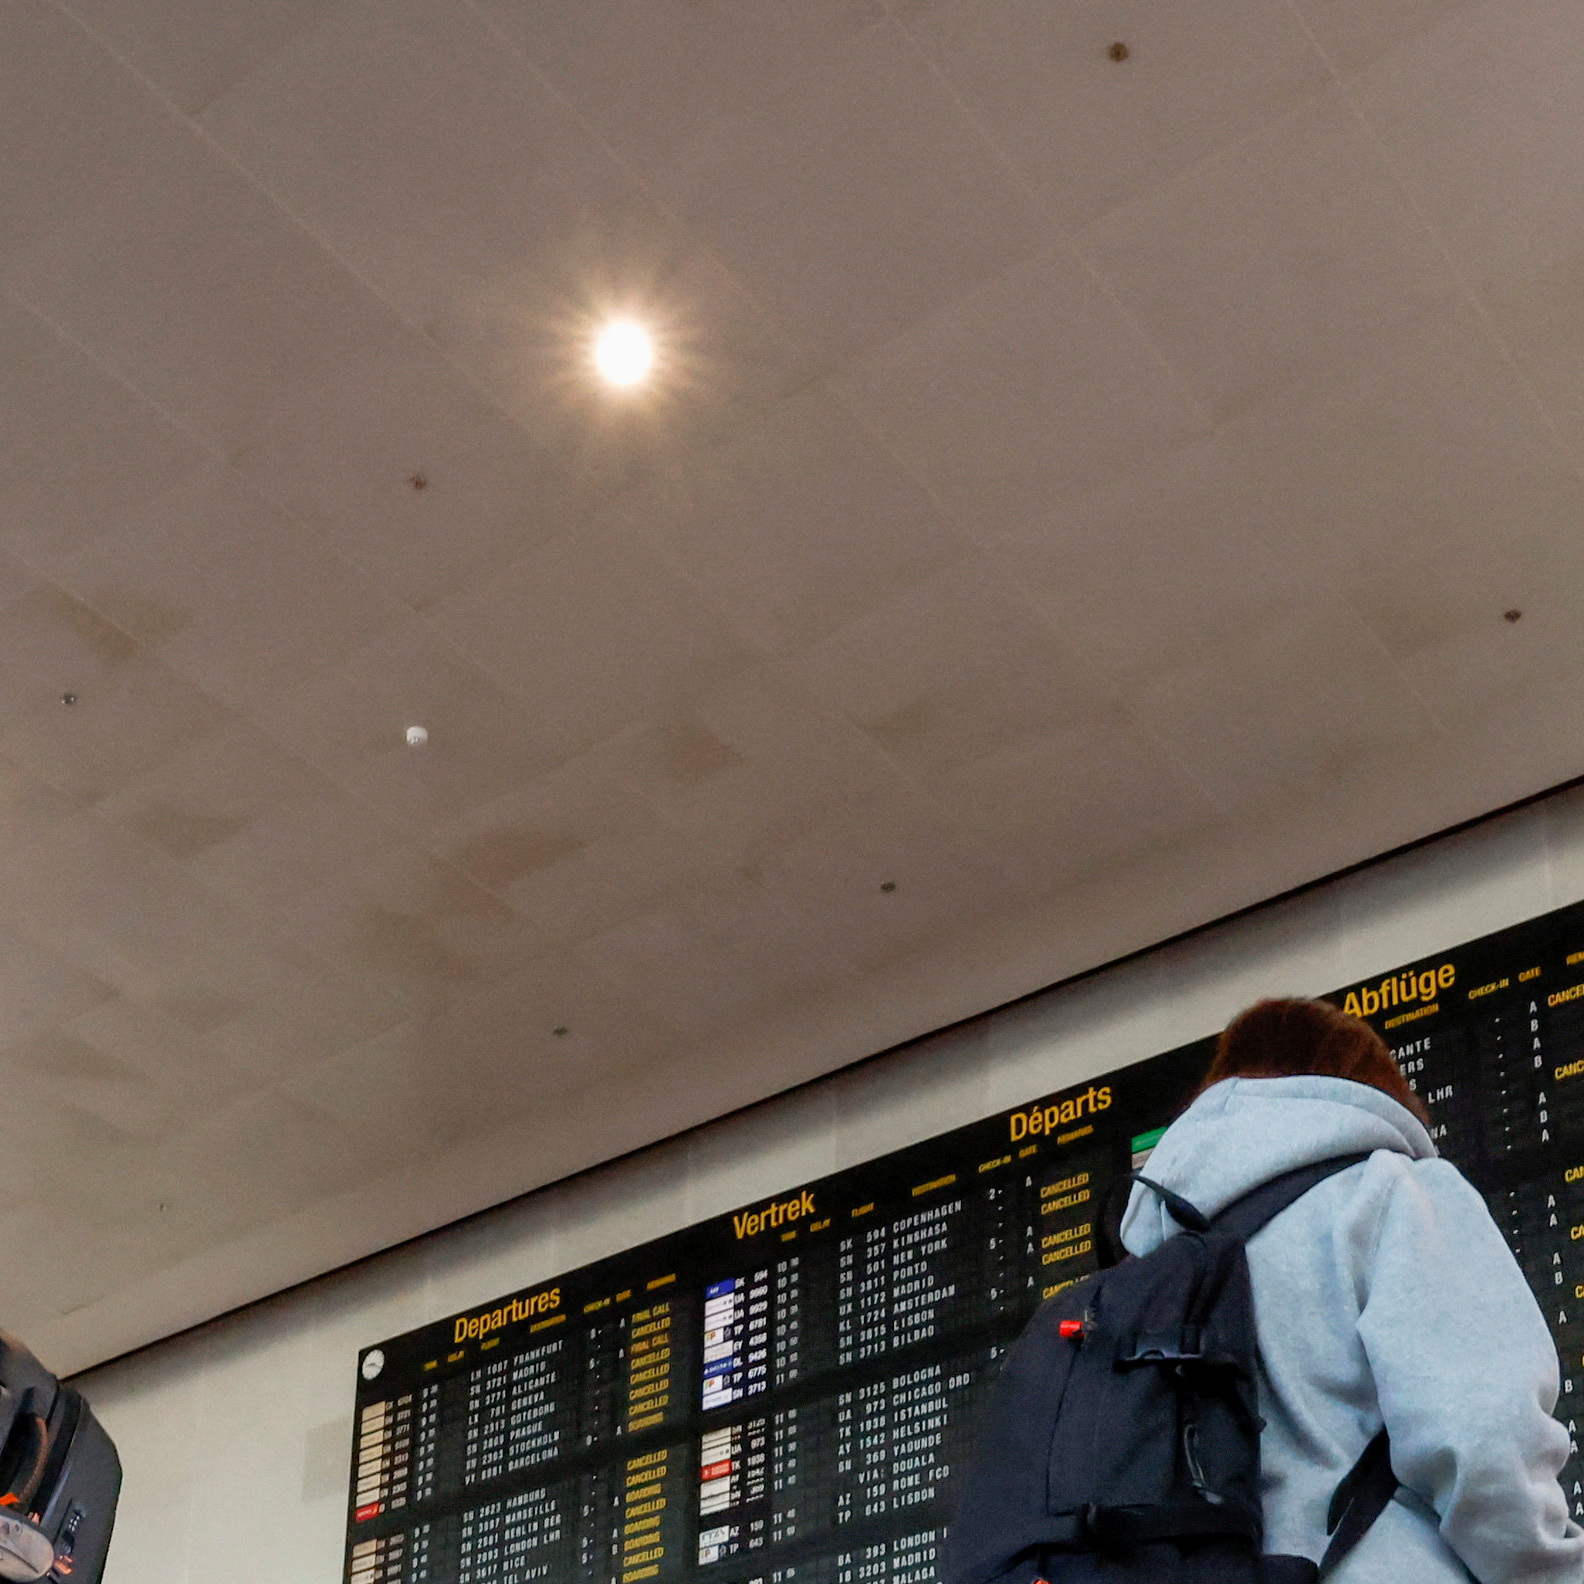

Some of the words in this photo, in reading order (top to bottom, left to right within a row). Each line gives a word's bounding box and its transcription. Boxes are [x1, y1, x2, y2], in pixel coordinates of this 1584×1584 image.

[1341, 964, 1454, 1026] Abflüge
[1468, 978, 1509, 999] CHECK-IN
[1518, 966, 1540, 982] GATE
[1428, 1085, 1453, 1103] LHR
[1010, 1087, 1111, 1140] Départs
[733, 1191, 814, 1238] Vertrek
[893, 1222, 947, 1248] KINSHASA
[1040, 1173, 1089, 1197] CANCELLED
[893, 1200, 961, 1233] COPENHAGEN
[893, 1249, 913, 1265] NEW
[921, 1237, 947, 1255] YORK
[1041, 1189, 1090, 1214] CANCELLED
[893, 1275, 933, 1297] MADRID
[1041, 1223, 1090, 1248] CANCELLED
[893, 1260, 927, 1281] PORTO
[860, 1307, 885, 1324] 1724
[893, 1284, 954, 1313] AMSTERDAM
[1042, 1240, 1091, 1264] CANCELLED
[454, 1288, 559, 1342] Departures
[893, 1308, 934, 1330] LISBON
[859, 1340, 885, 1358] 3713
[893, 1325, 934, 1347] BILBAO
[512, 1371, 555, 1395] ALICANTE
[892, 1365, 940, 1389] BOLOGNA
[892, 1381, 941, 1405] CHICAGO
[948, 1373, 969, 1389] ORD
[894, 1397, 947, 1422] ISTANBUL
[892, 1414, 947, 1439] HELSINKI
[893, 1433, 941, 1456] YAOUNDE
[892, 1452, 934, 1474] DOUALA
[892, 1473, 920, 1490] ROME
[928, 1465, 949, 1481] FCO
[893, 1487, 934, 1508] LISBON
[504, 1536, 537, 1555] LONDON
[893, 1530, 935, 1551] LONDON
[623, 1547, 663, 1566] CANCELLED
[893, 1547, 935, 1569] MADRID
[524, 1564, 547, 1580] AVIV
